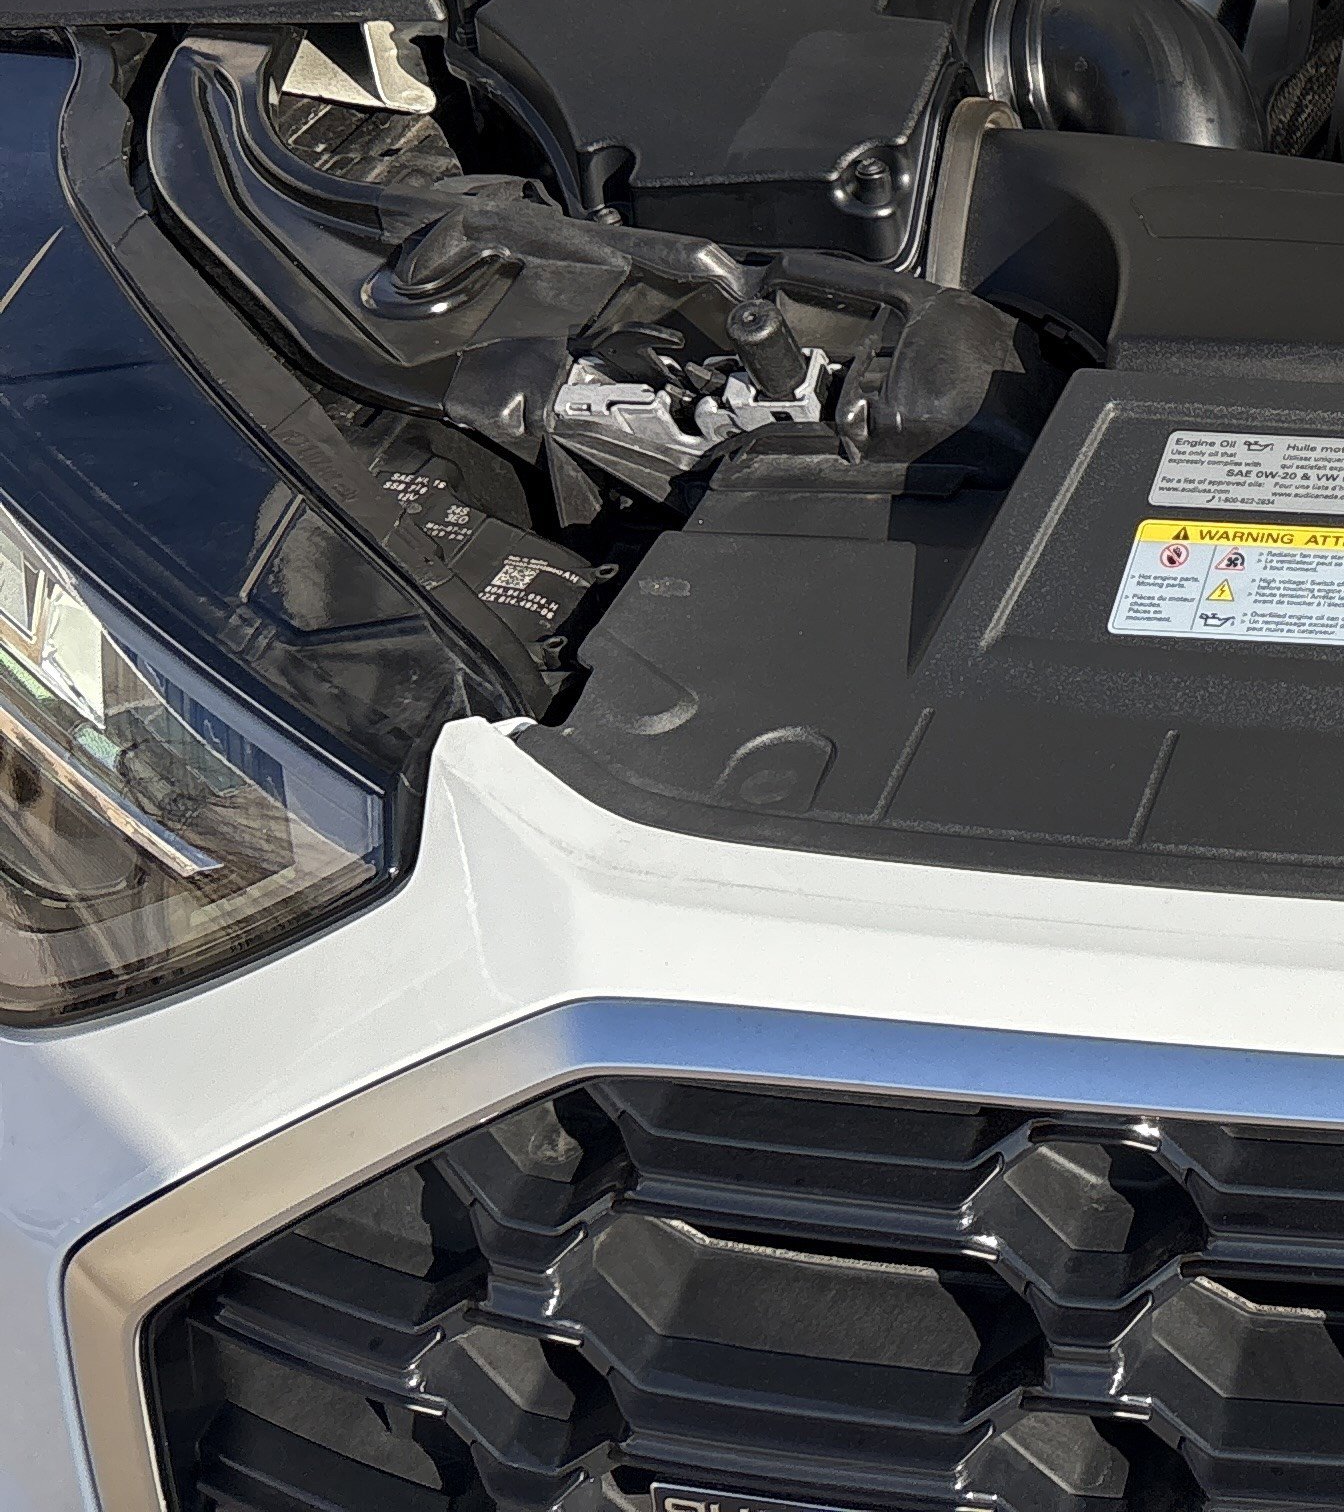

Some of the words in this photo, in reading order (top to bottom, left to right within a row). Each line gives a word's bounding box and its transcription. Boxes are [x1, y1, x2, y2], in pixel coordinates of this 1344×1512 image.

[1175, 438, 1216, 448] Engine
[1220, 440, 1237, 448] Oil
[1287, 444, 1317, 452] Huile
[1168, 458, 1205, 466] expressly
[1226, 469, 1253, 477] SAE
[1256, 471, 1297, 480] 0W-20
[1301, 473, 1311, 481] &
[1316, 474, 1340, 482] VW
[1161, 476, 1175, 484] For
[1208, 480, 1246, 488] approved
[1198, 529, 1294, 545] WARNING
[1259, 578, 1277, 587] High
[1282, 586, 1315, 594] touching
[1317, 587, 1342, 595] engine
